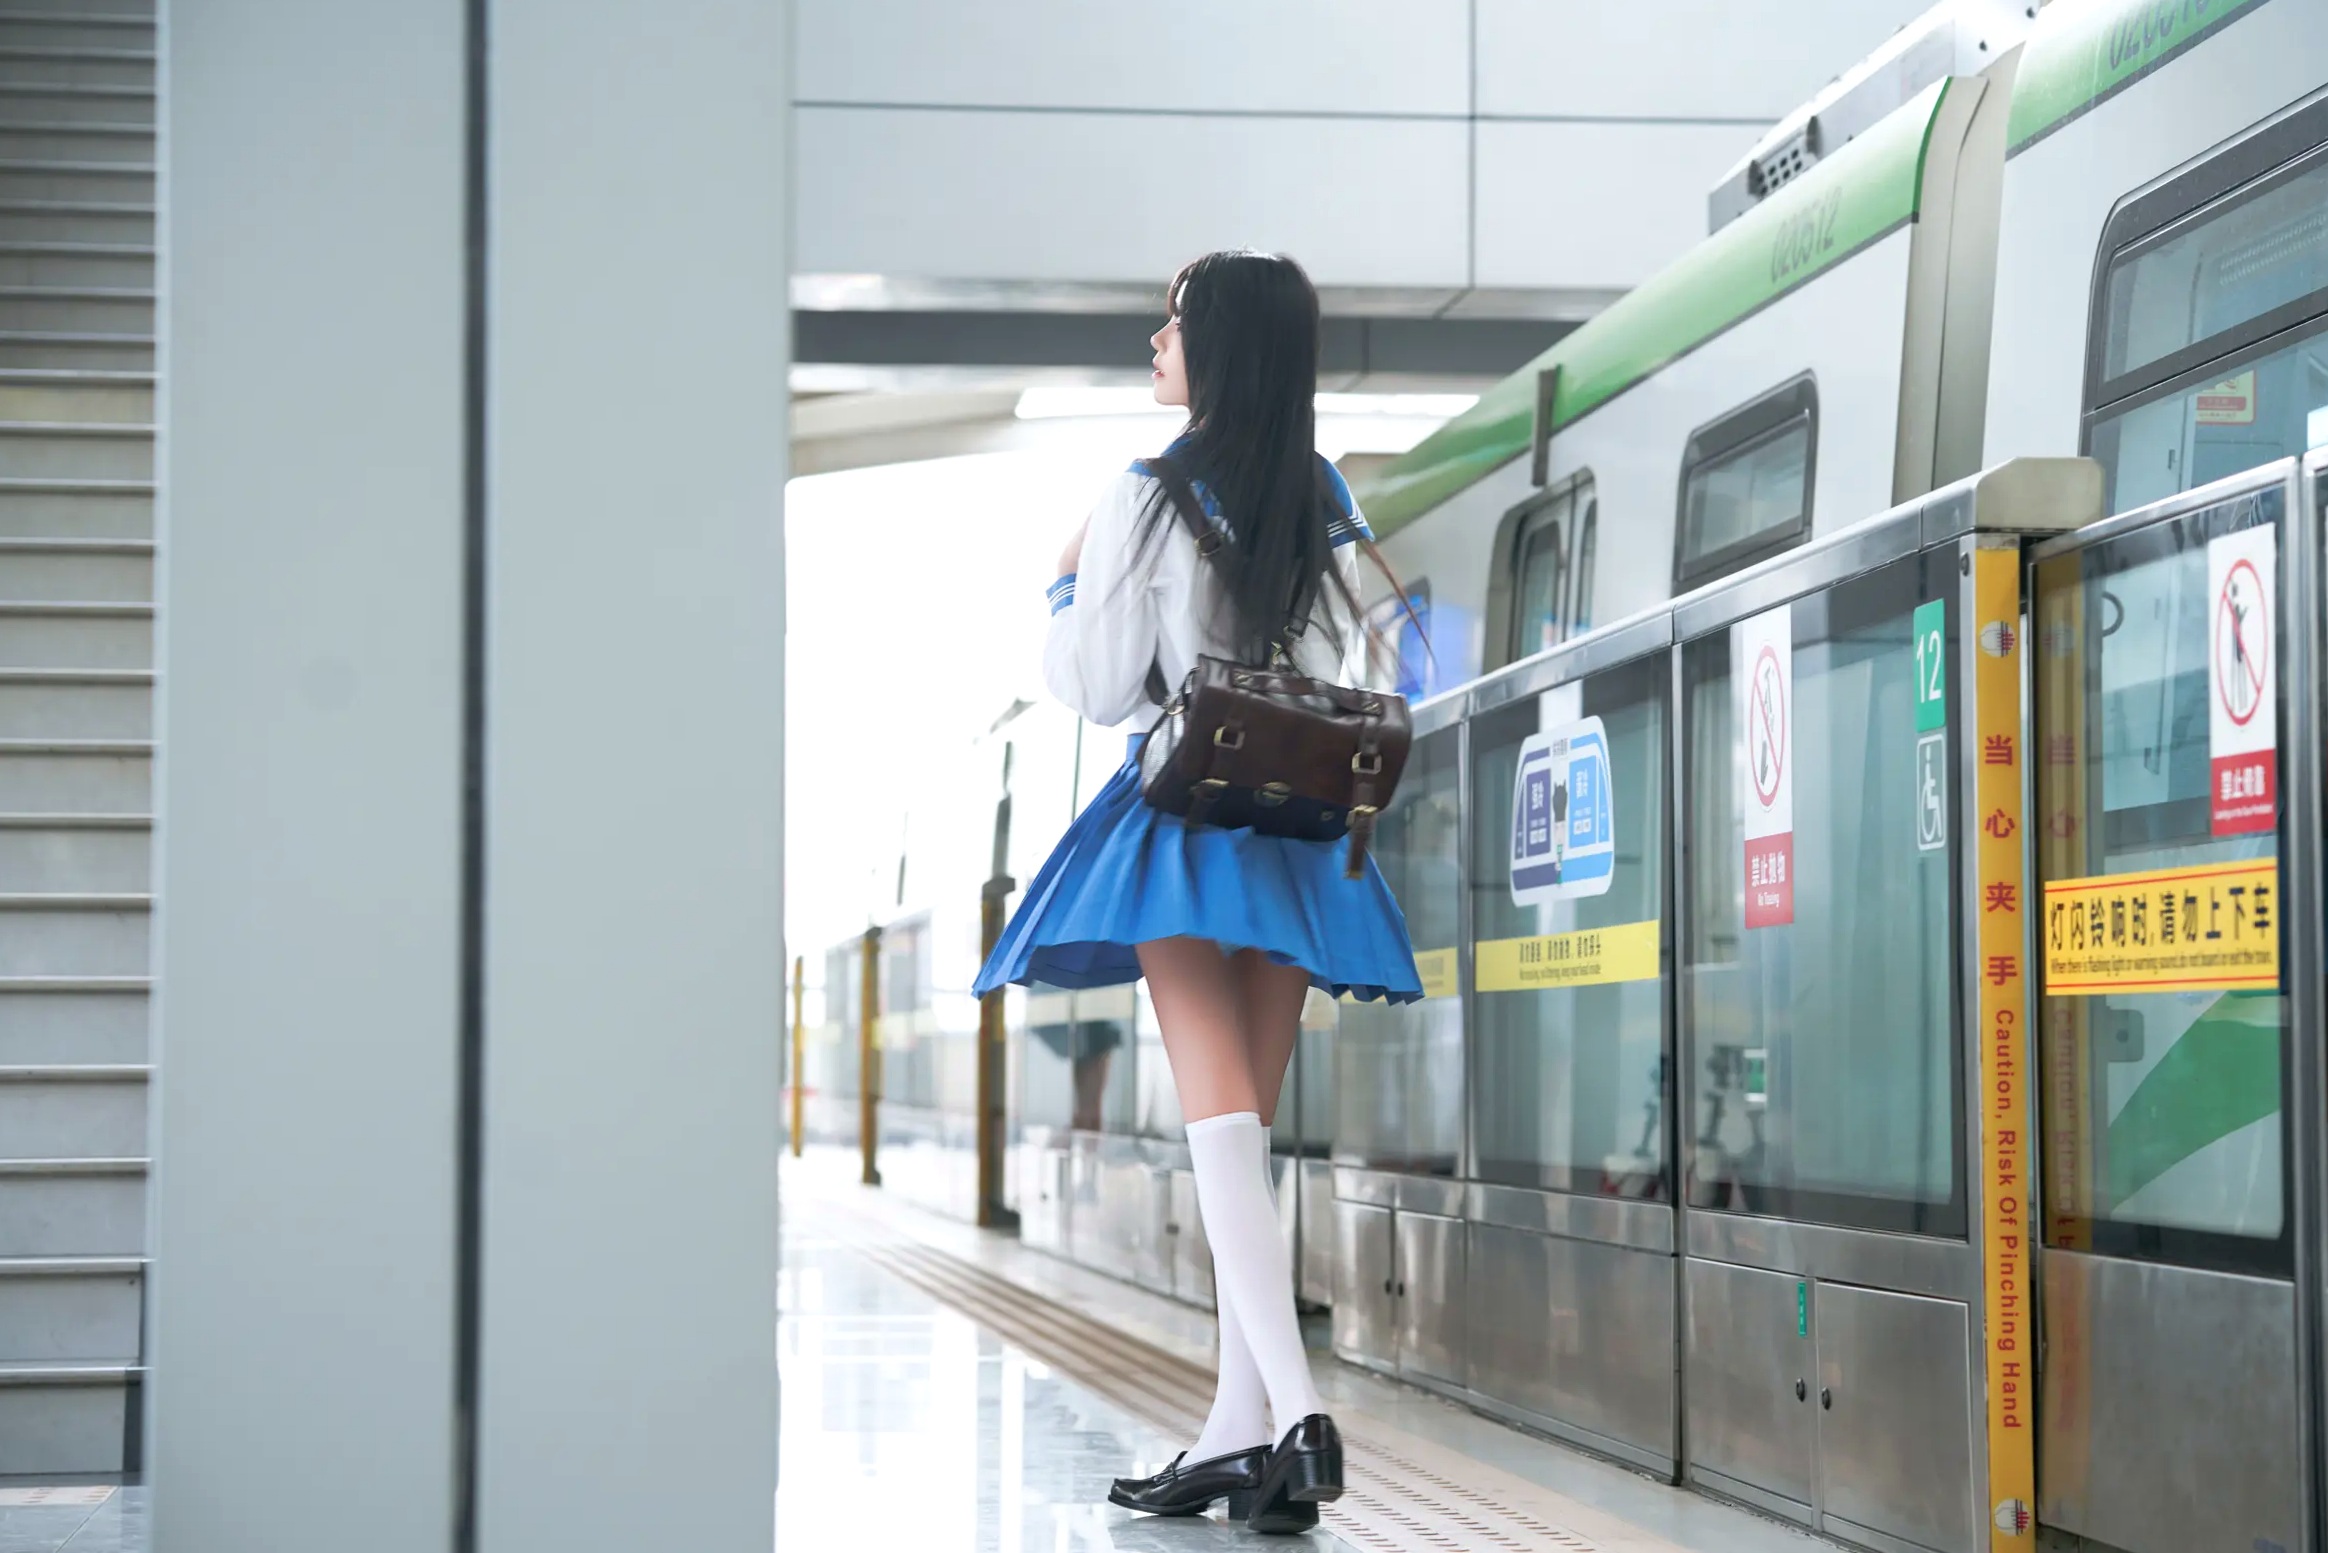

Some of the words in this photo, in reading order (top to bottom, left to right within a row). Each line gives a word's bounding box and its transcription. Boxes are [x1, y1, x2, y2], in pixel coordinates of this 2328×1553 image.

[1916, 630, 1942, 703] 12
[1985, 734, 2018, 986] 当心夹手
[1995, 1009, 2015, 1119] Caution,
[1998, 1130, 2016, 1186] Risk
[1999, 1197, 2017, 1226] Of
[1996, 1235, 2020, 1351] Pinching
[2002, 1362, 2021, 1428] Hand
